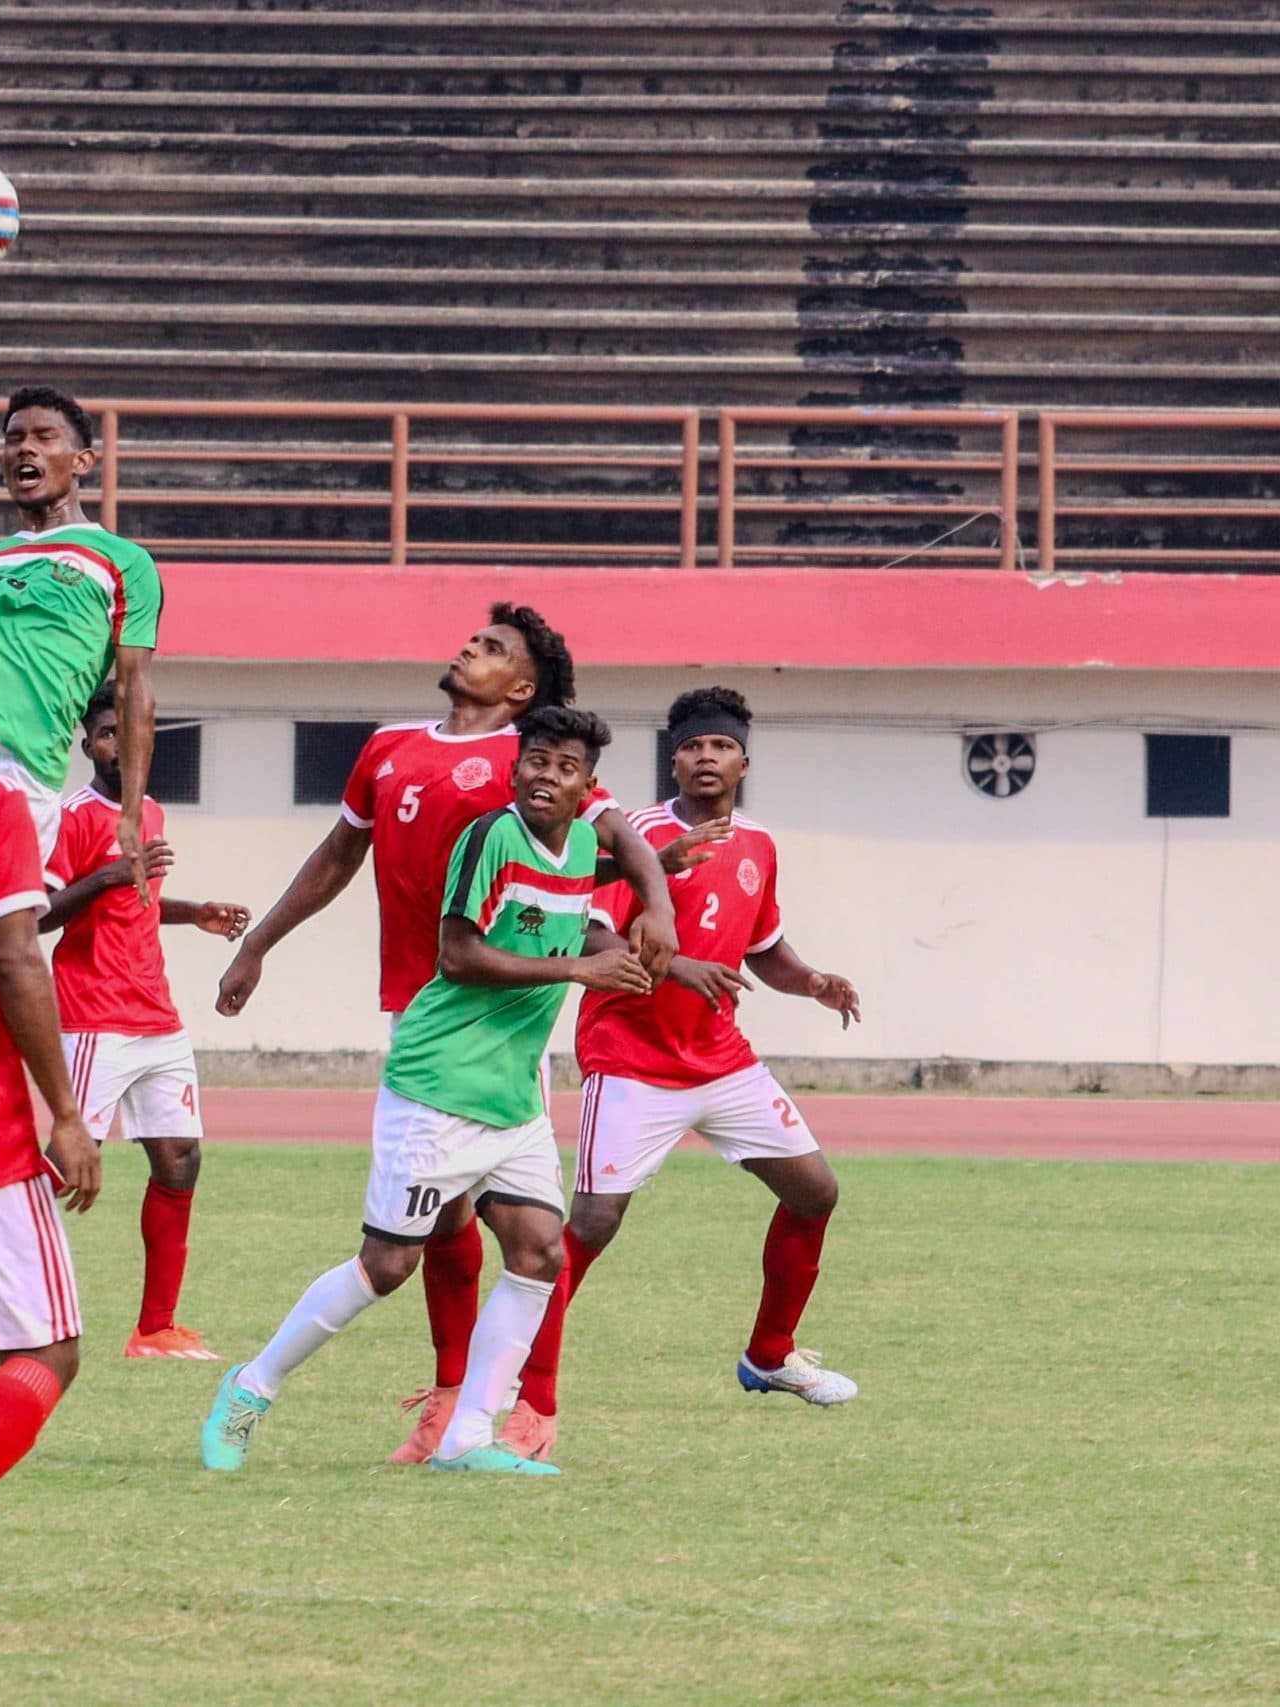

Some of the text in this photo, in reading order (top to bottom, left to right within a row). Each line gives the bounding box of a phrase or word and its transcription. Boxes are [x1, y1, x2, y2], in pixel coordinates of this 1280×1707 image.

[397, 784, 425, 823] 5
[698, 891, 720, 931] 2
[181, 1083, 195, 1116] 4
[772, 1096, 799, 1129] 2
[406, 1184, 441, 1217] 10
